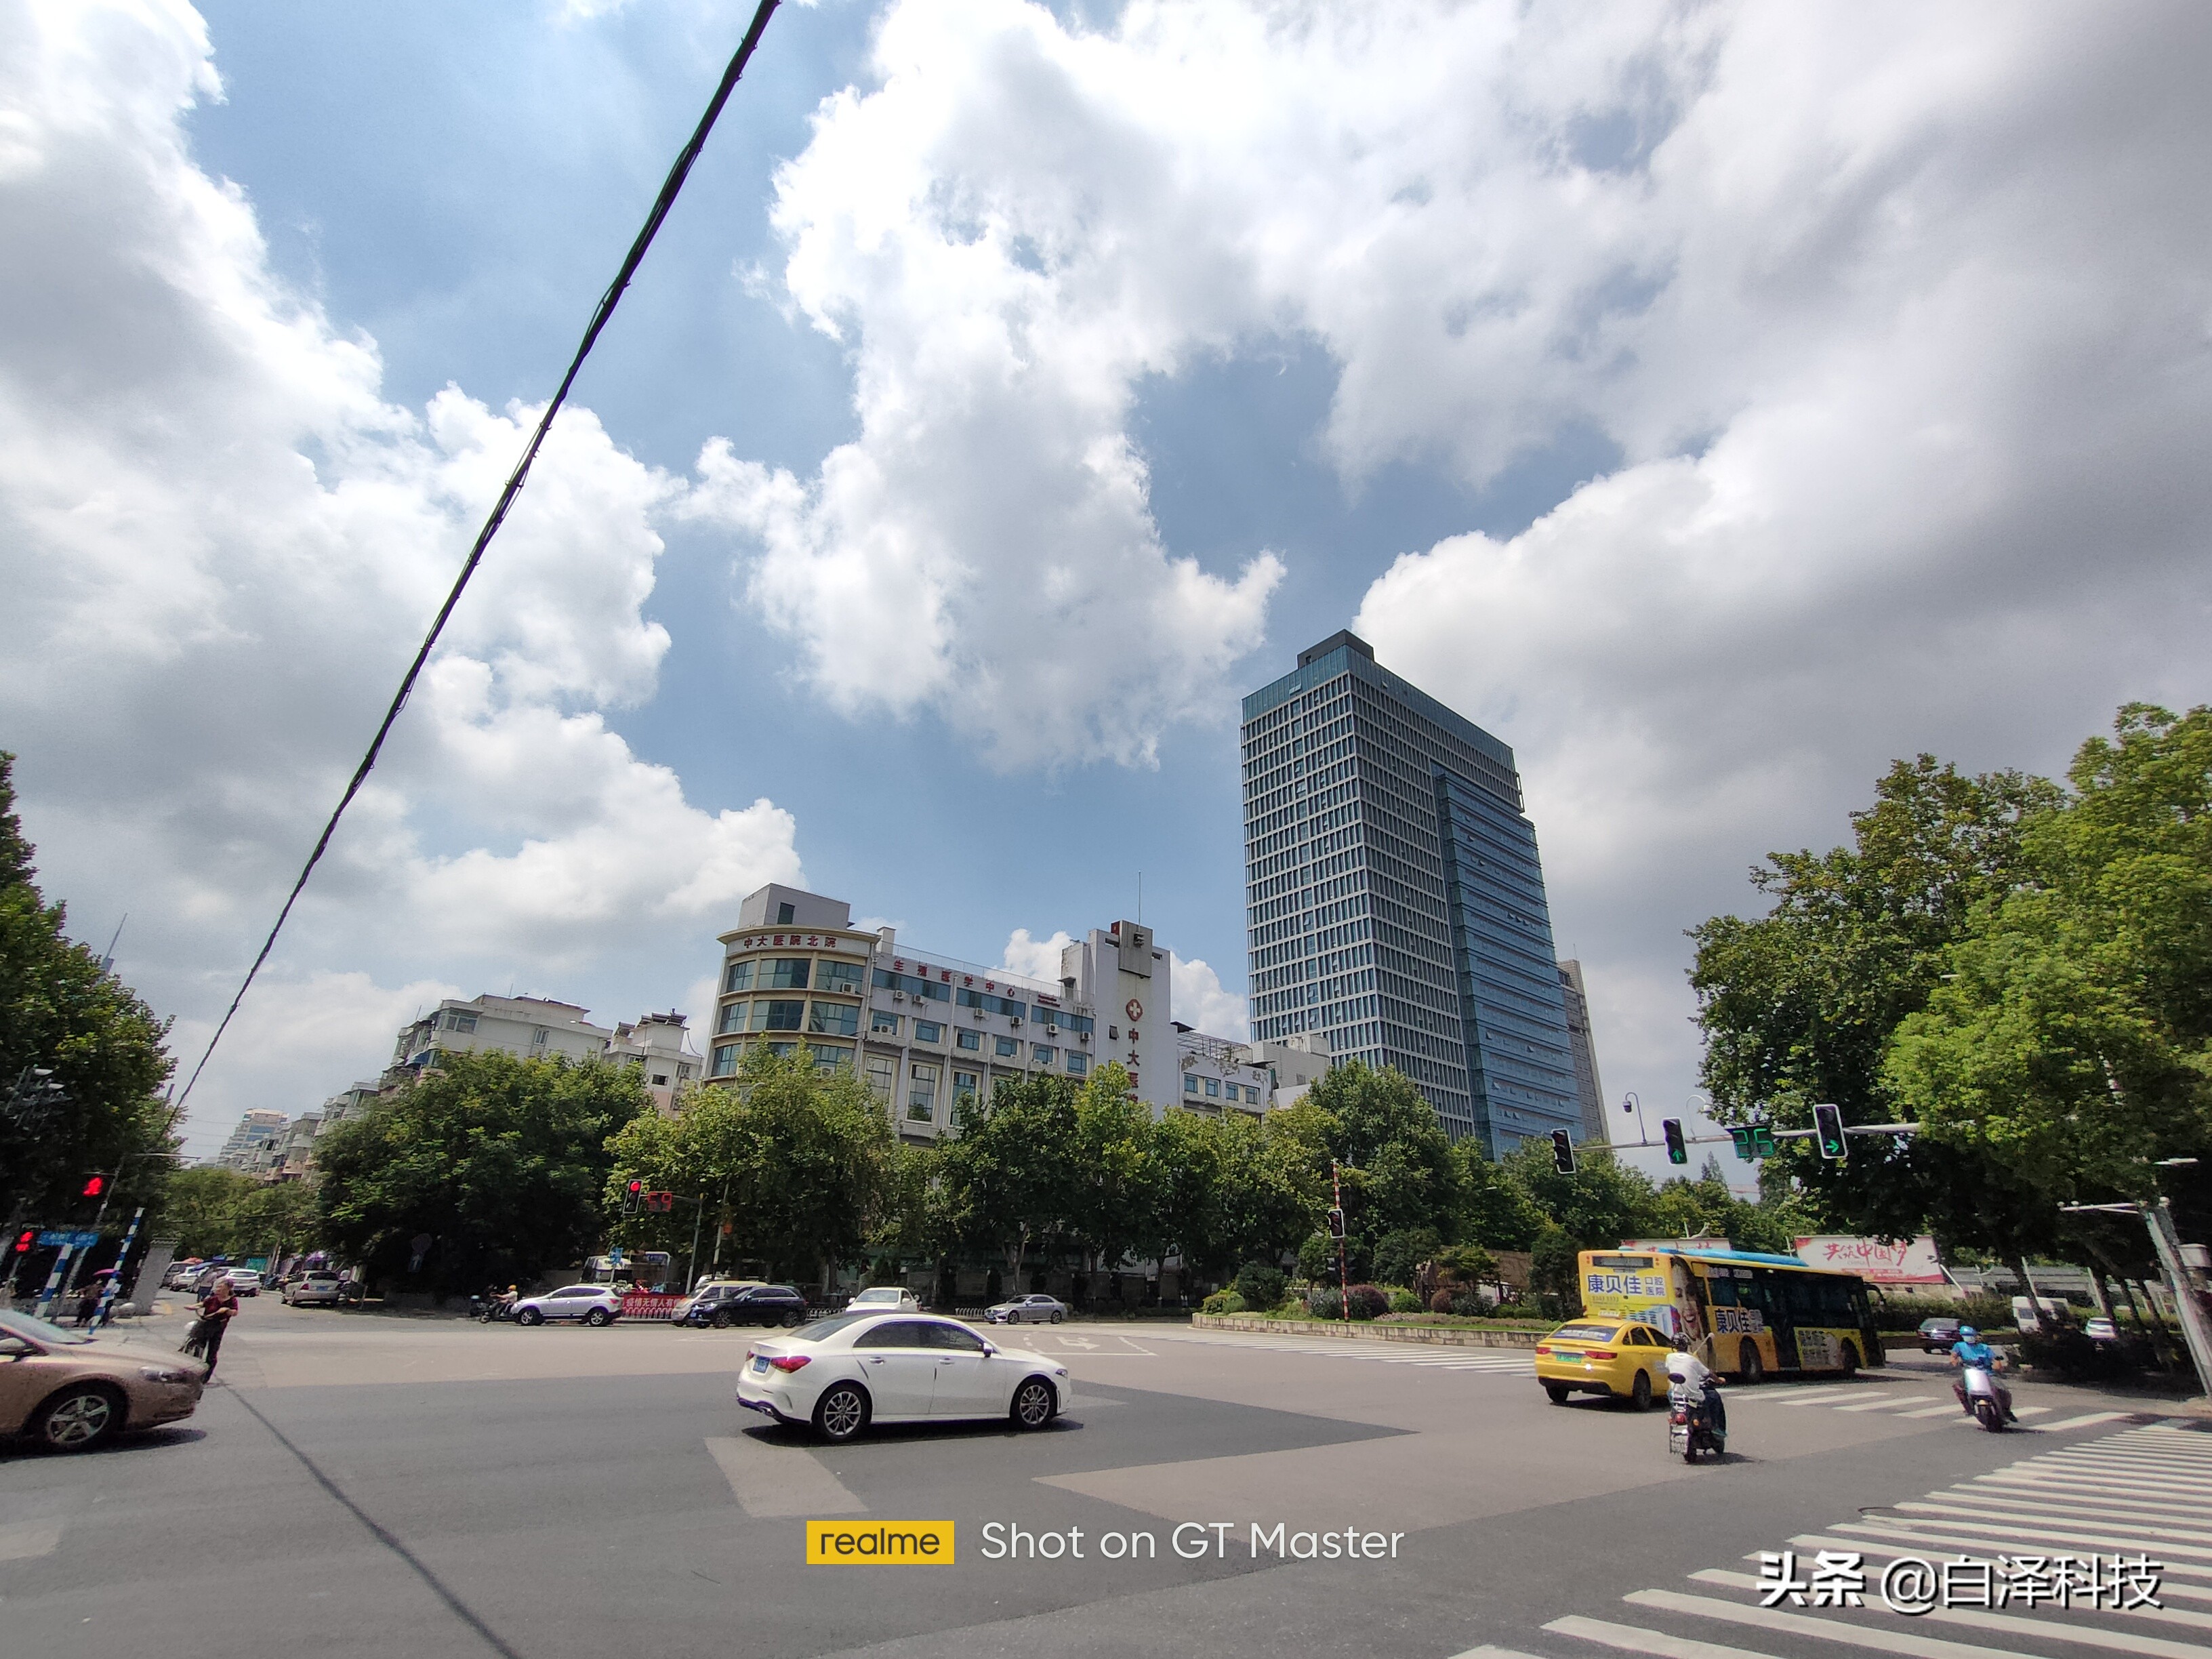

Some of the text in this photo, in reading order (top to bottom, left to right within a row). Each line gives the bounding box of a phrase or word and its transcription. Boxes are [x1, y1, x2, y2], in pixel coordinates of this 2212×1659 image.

[743, 934, 837, 949] 中大医院北院
[893, 958, 1016, 998] 生殖医学中心
[1733, 1128, 1775, 1158] 25
[647, 1191, 673, 1212] 59
[1587, 1274, 1643, 1294] 康贝佳
[1715, 1307, 1752, 1333] 康贝佳
